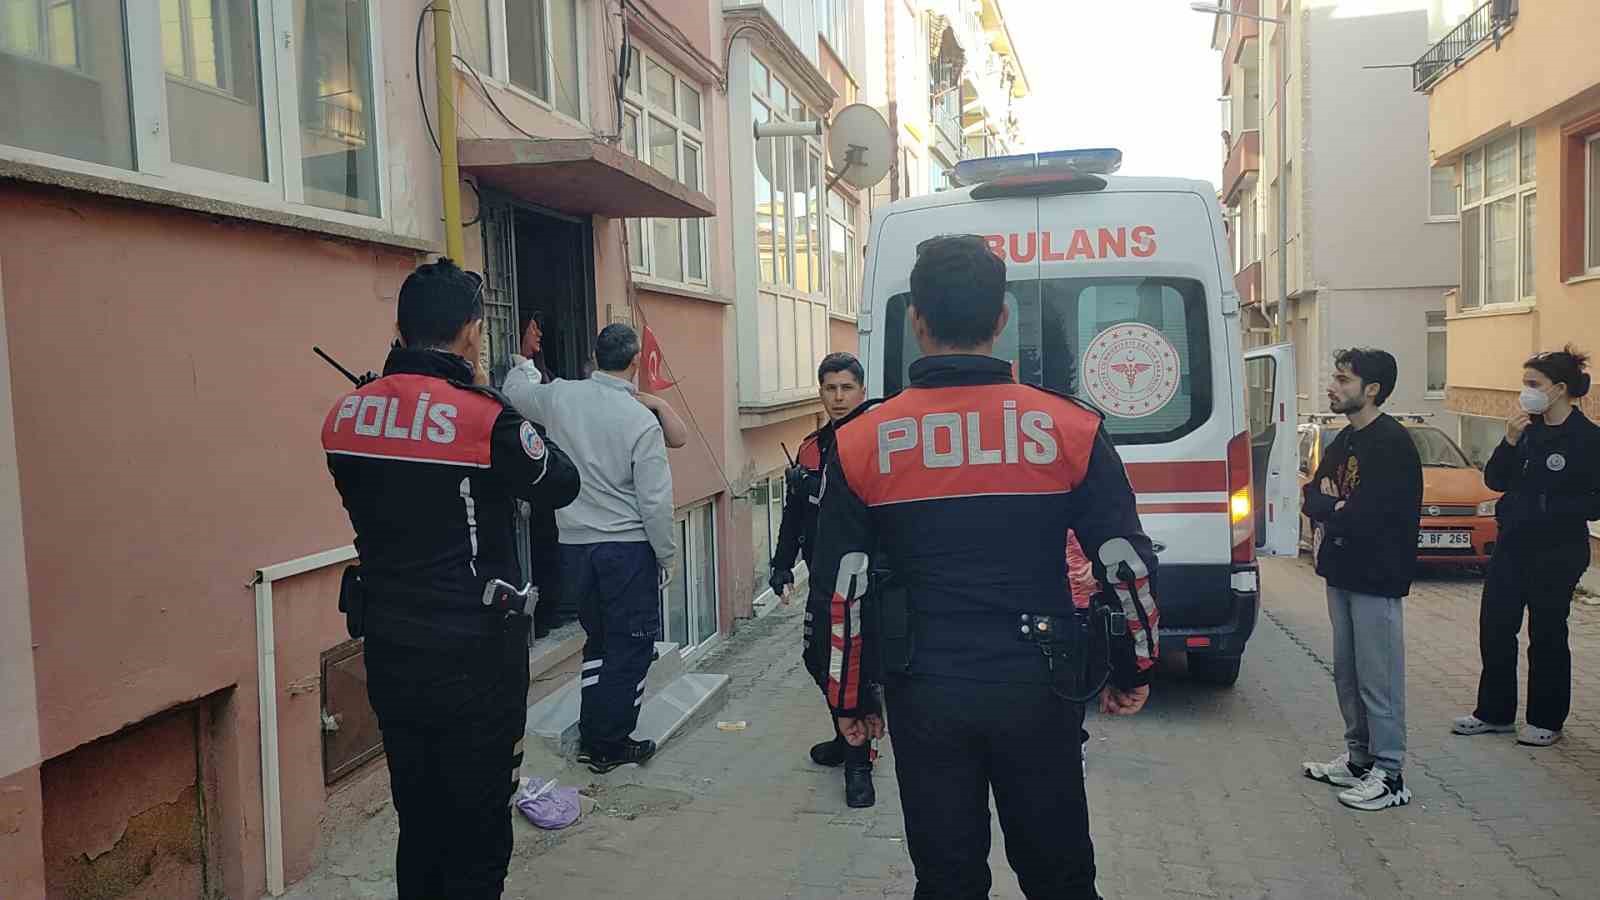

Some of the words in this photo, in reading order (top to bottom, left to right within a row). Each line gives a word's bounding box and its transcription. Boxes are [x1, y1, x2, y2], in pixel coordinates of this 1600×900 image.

[333, 392, 458, 444] POLİS
[877, 400, 1058, 474] POLİS
[1430, 534, 1442, 544] BF
[1448, 534, 1469, 544] 265
